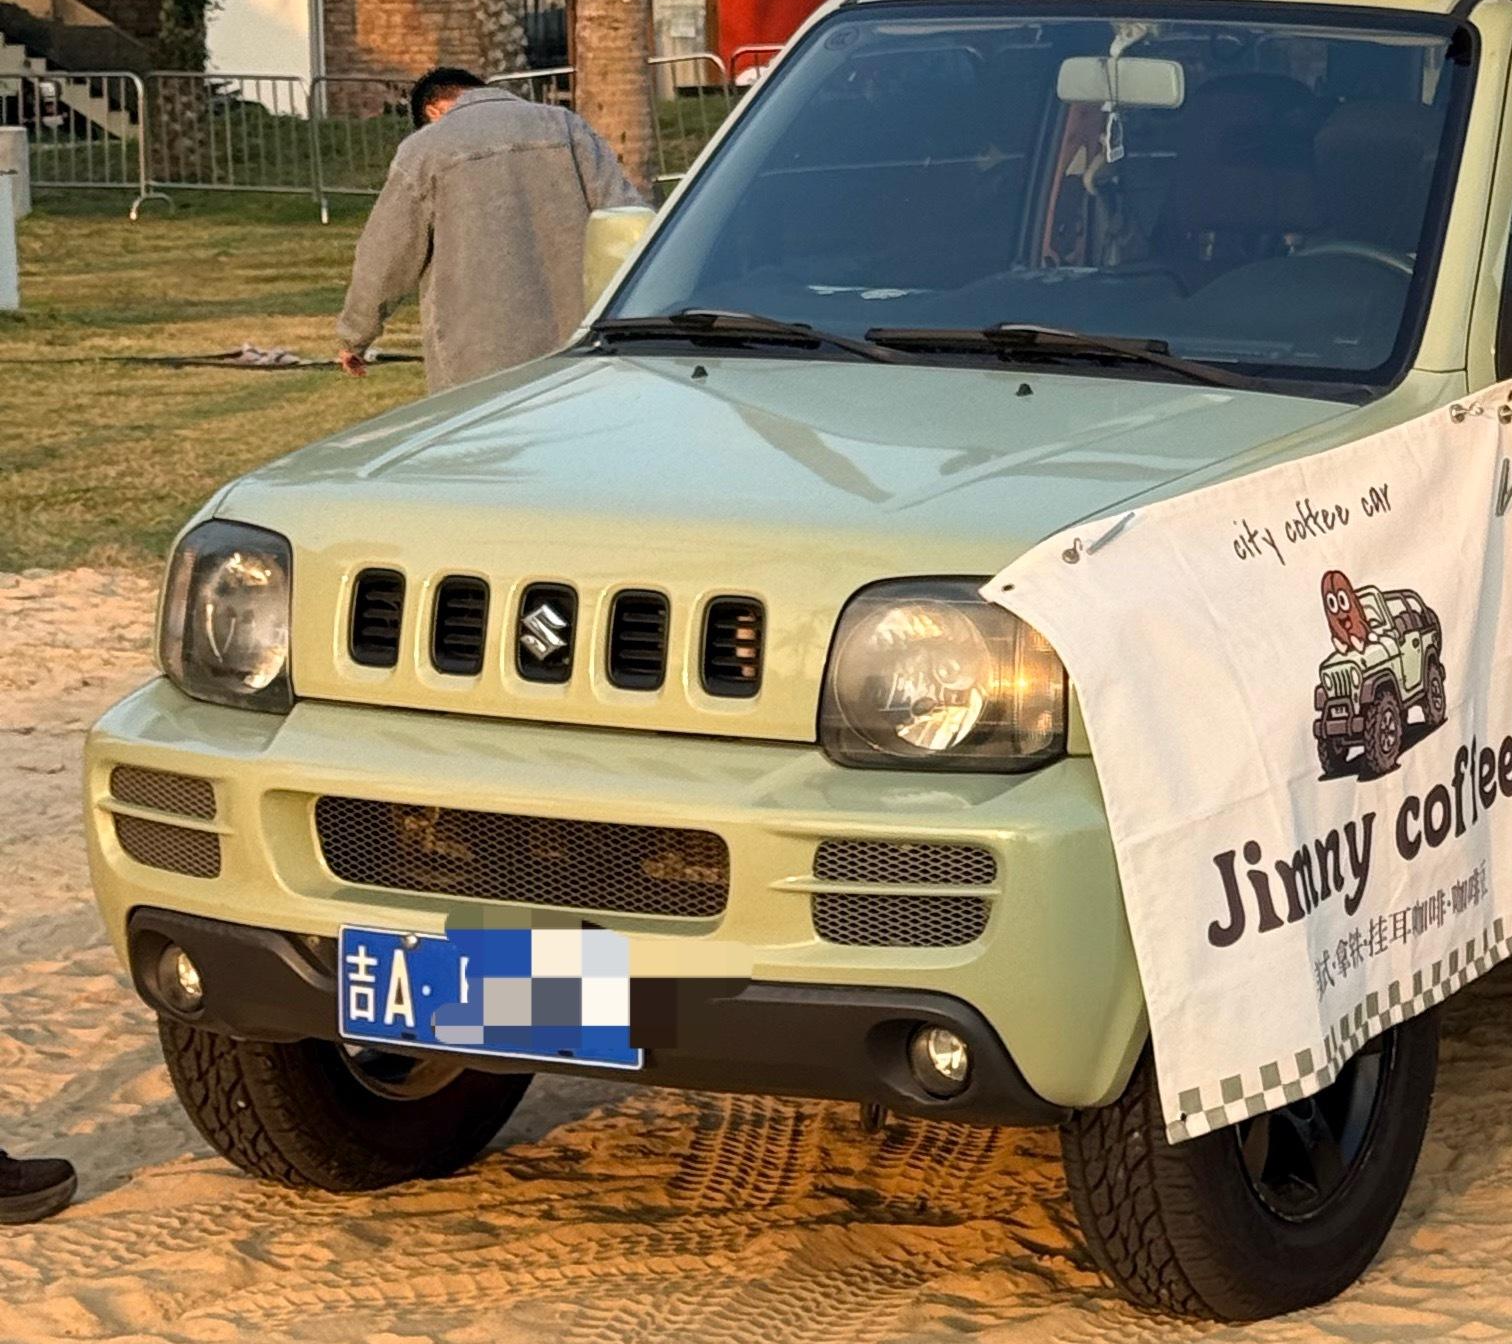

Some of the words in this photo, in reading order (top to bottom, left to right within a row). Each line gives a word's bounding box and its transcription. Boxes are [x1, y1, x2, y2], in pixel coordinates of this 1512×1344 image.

[1233, 519, 1286, 565] city
[1285, 498, 1349, 543] coffee
[1361, 483, 1392, 517] car
[1207, 811, 1377, 948] Jimny
